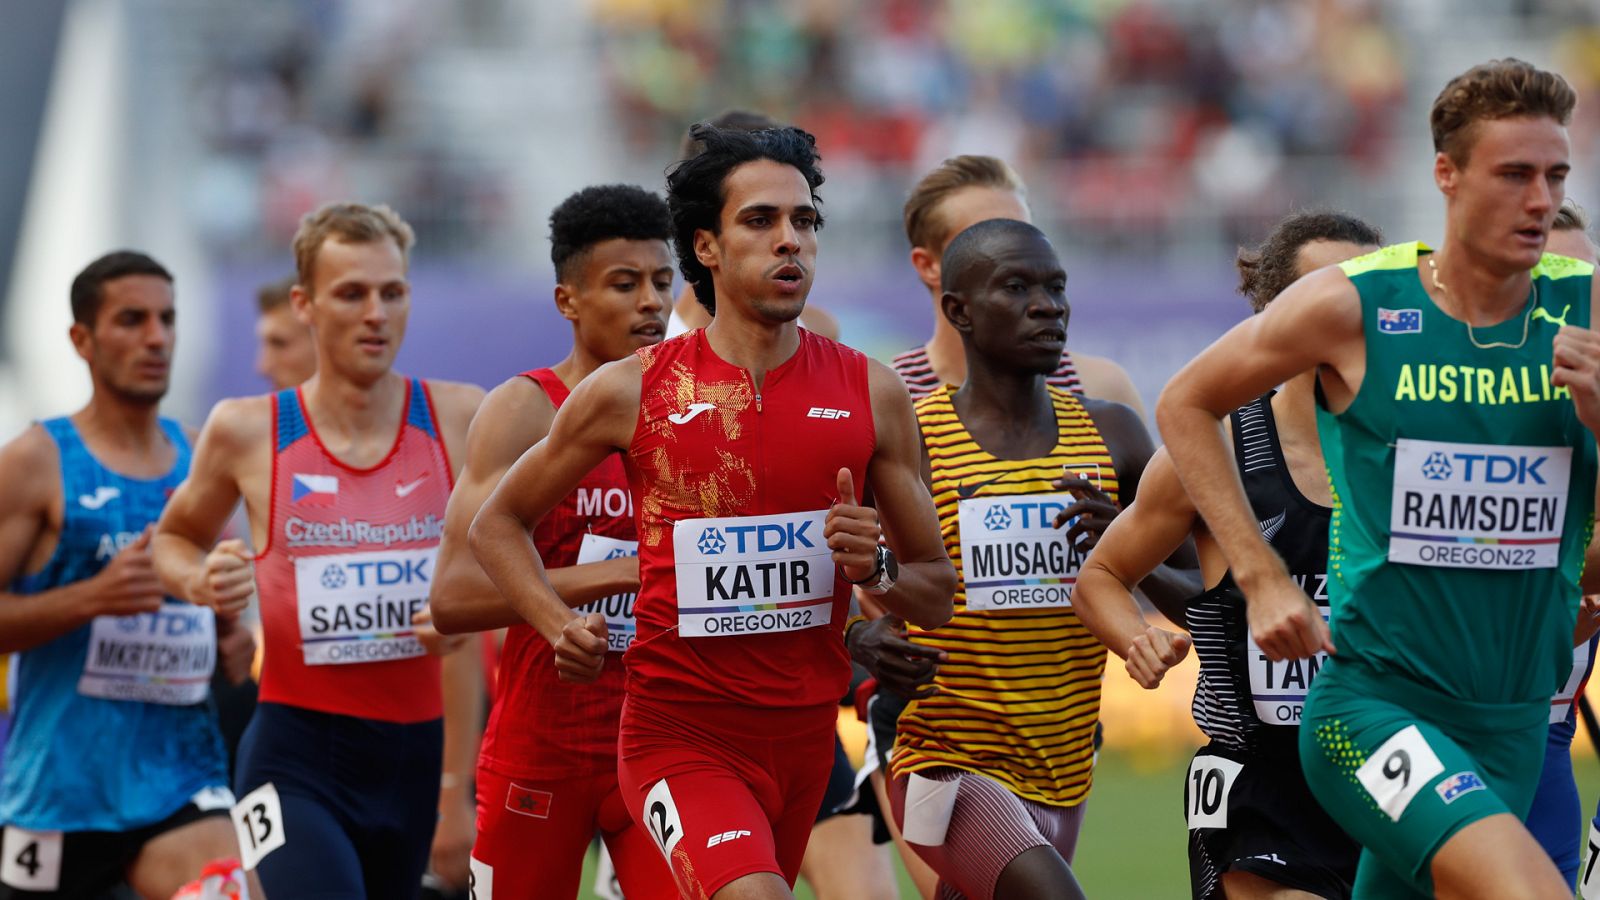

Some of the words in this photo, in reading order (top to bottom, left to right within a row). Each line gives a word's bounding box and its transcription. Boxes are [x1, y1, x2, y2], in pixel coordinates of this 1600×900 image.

[807, 407, 851, 420] ESP
[1453, 453, 1549, 485] TDK
[576, 487, 634, 518] MO
[1403, 490, 1558, 533] RAMSDEN
[285, 513, 446, 547] CzechRepublic
[725, 520, 815, 554] TDK
[347, 557, 429, 586] TDK
[971, 541, 1088, 578] MUSAGA
[1419, 545, 1536, 566] OREGON22
[705, 560, 811, 601] KATIR
[992, 588, 1072, 606] OREGON
[311, 594, 432, 634] SASÍNE
[704, 610, 812, 634] OREGON22
[1382, 749, 1411, 792] 9
[1193, 767, 1226, 816] 10
[242, 802, 273, 850] 13
[707, 829, 752, 849] ESP
[16, 840, 41, 879] 4
